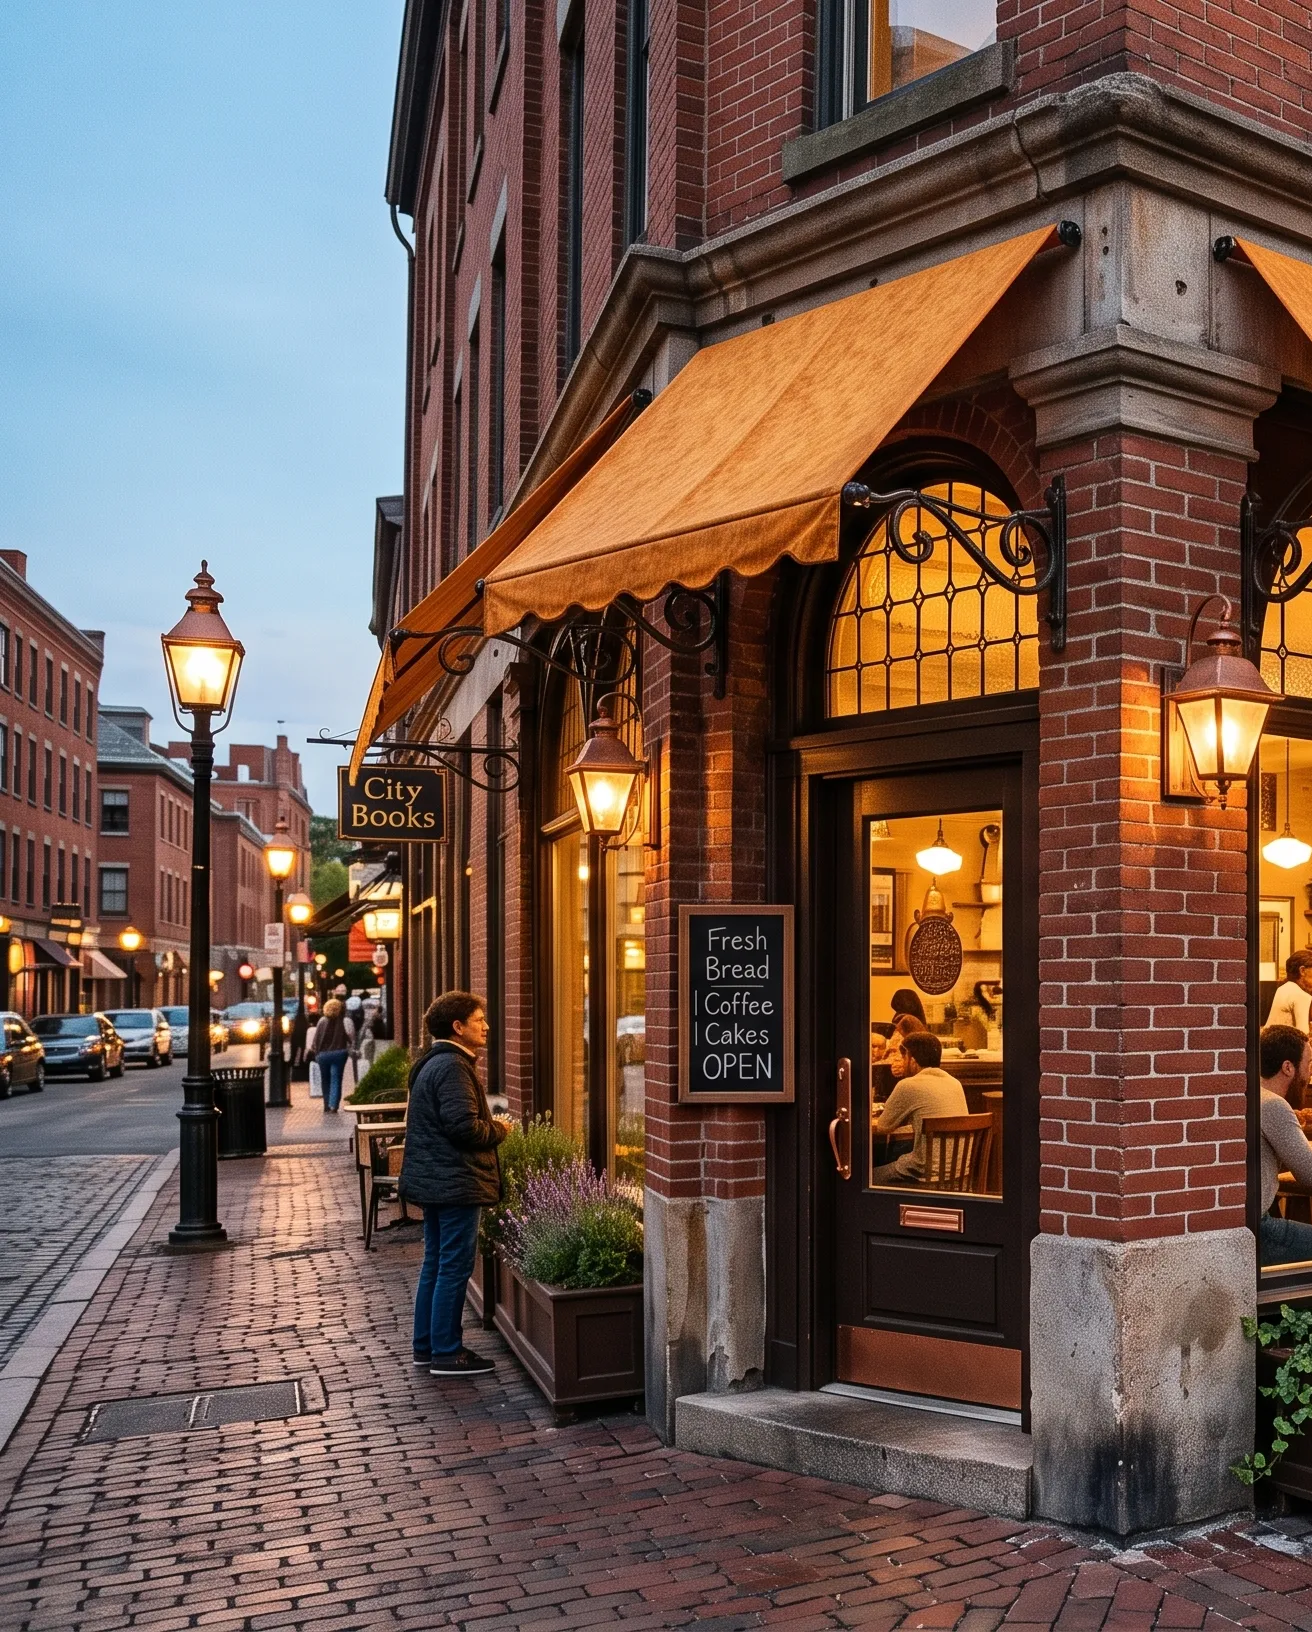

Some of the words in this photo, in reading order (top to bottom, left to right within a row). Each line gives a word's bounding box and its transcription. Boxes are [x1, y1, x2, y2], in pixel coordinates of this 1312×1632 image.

[364, 777, 423, 806] City
[351, 804, 436, 828] Books
[708, 926, 767, 951] Fresh
[706, 954, 769, 981] Bread
[704, 991, 774, 1016] Coffee
[705, 1022, 769, 1046] Cakes
[702, 1053, 772, 1080] OPEN
